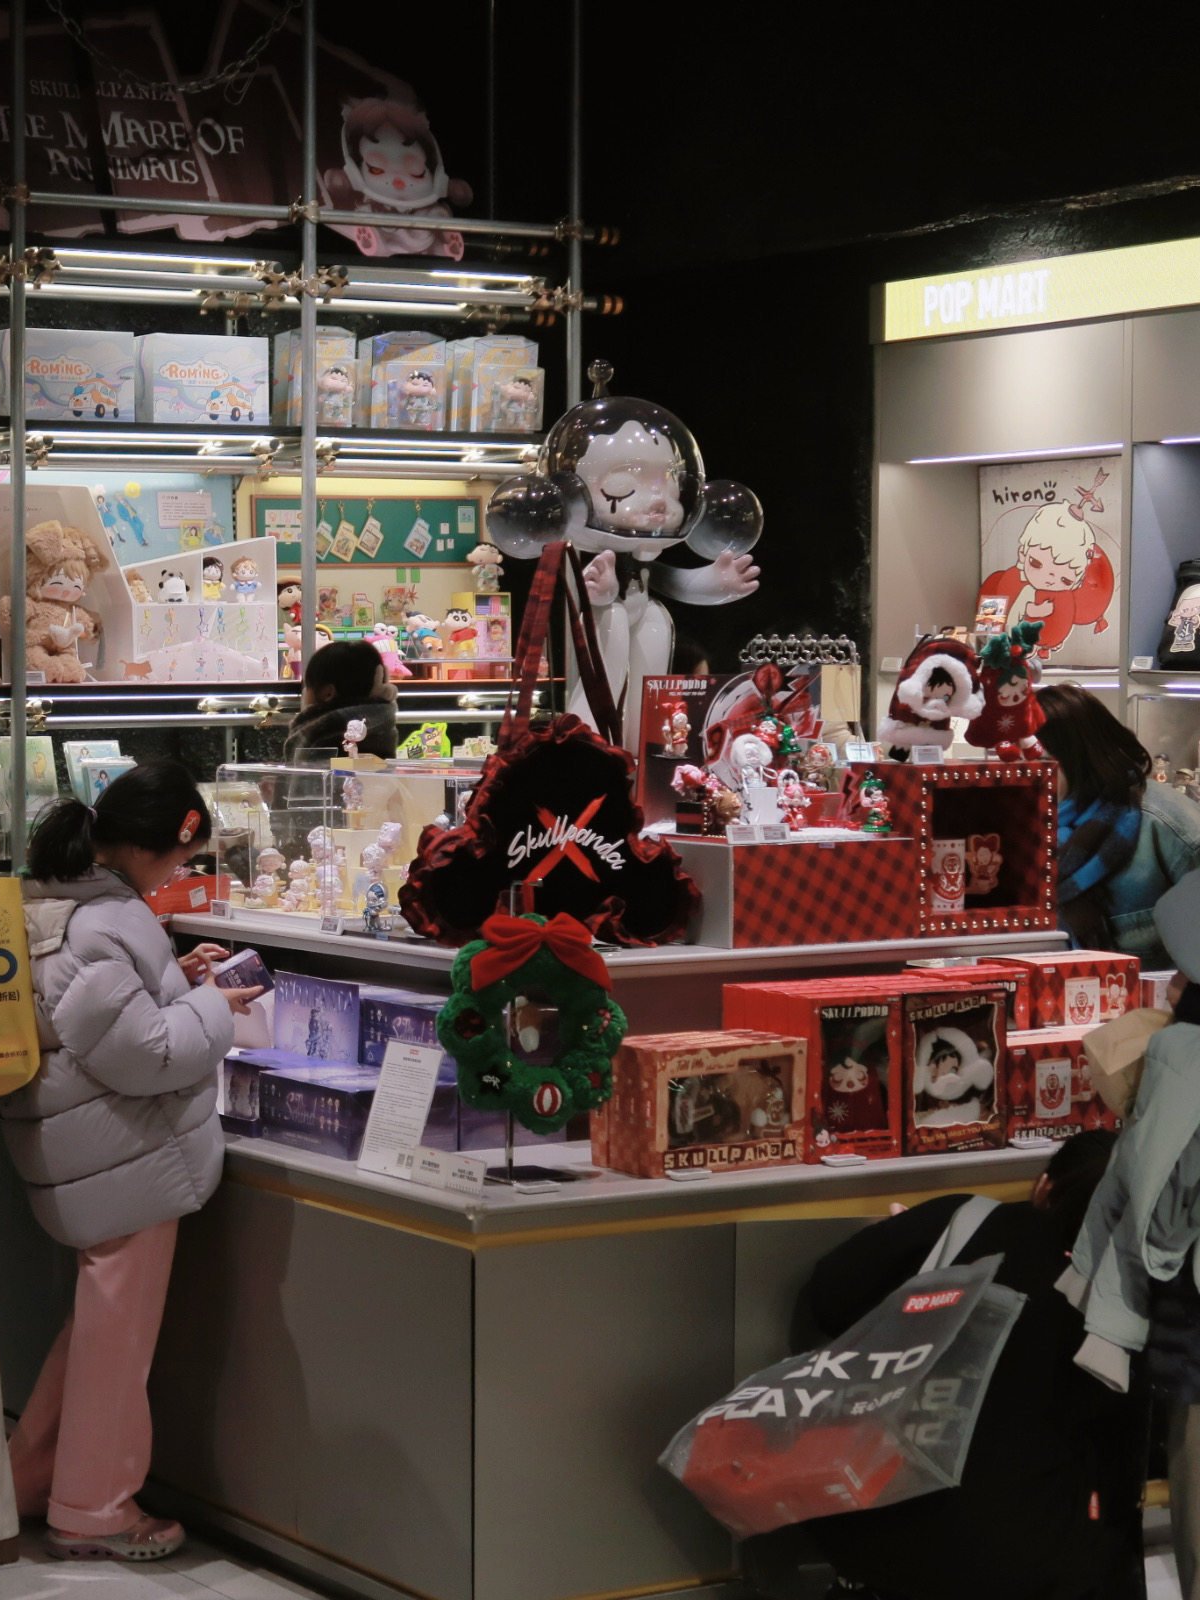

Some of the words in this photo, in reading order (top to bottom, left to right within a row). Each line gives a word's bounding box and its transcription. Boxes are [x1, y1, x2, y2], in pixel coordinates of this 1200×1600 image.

[196, 117, 245, 155] OF
[923, 281, 970, 327] POP
[978, 269, 1050, 320] MART
[992, 481, 1058, 506] hirono
[507, 814, 627, 870] Skullpanda
[663, 1139, 797, 1169] SKULLPANDA
[906, 1297, 930, 1311] POP
[930, 1291, 961, 1307] MART
[866, 1343, 934, 1379] TO
